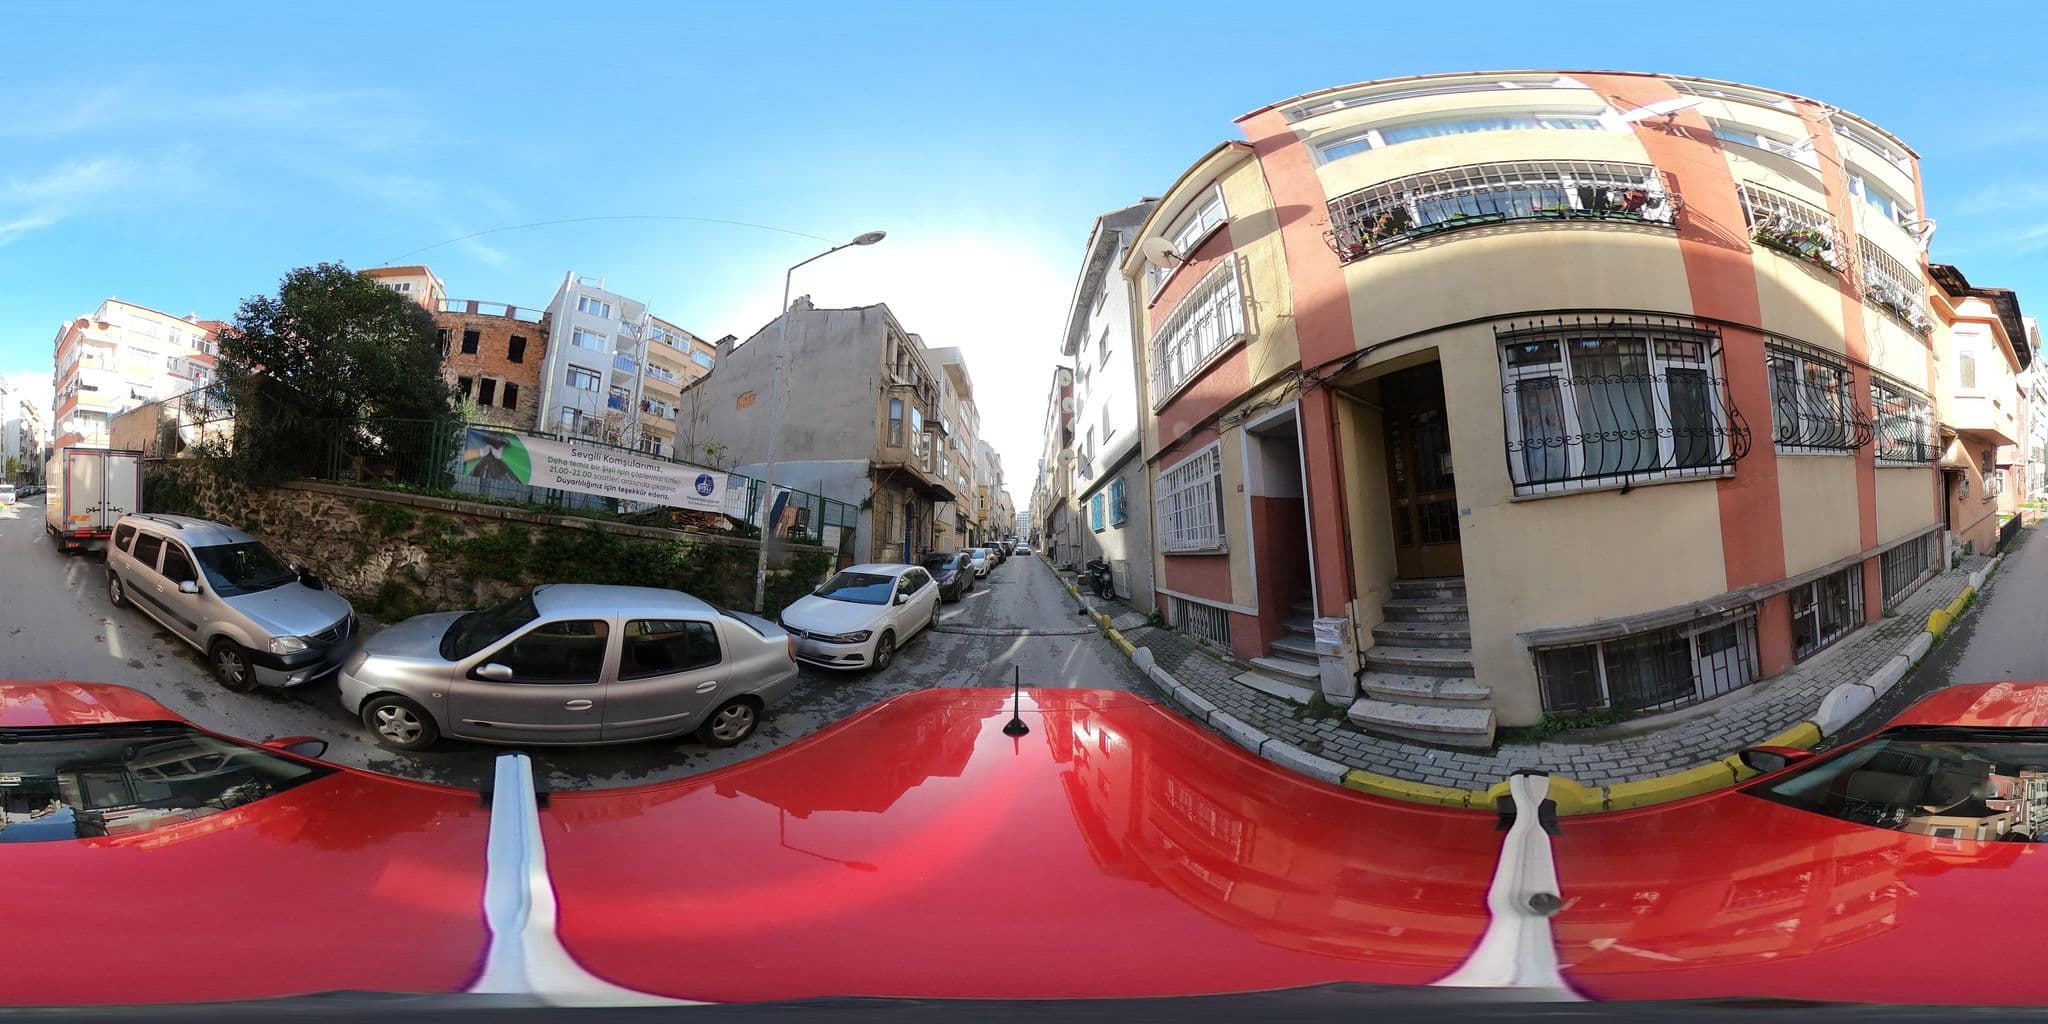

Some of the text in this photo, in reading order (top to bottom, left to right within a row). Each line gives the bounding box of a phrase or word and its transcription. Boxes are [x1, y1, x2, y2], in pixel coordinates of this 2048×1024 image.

[571, 448, 602, 461] Sevgili
[548, 456, 568, 466] Daha
[570, 460, 589, 469] temiz
[550, 466, 592, 478] 21.00-22.00
[556, 476, 670, 500] Duyarlılığınız için teşekkür ederiz.
